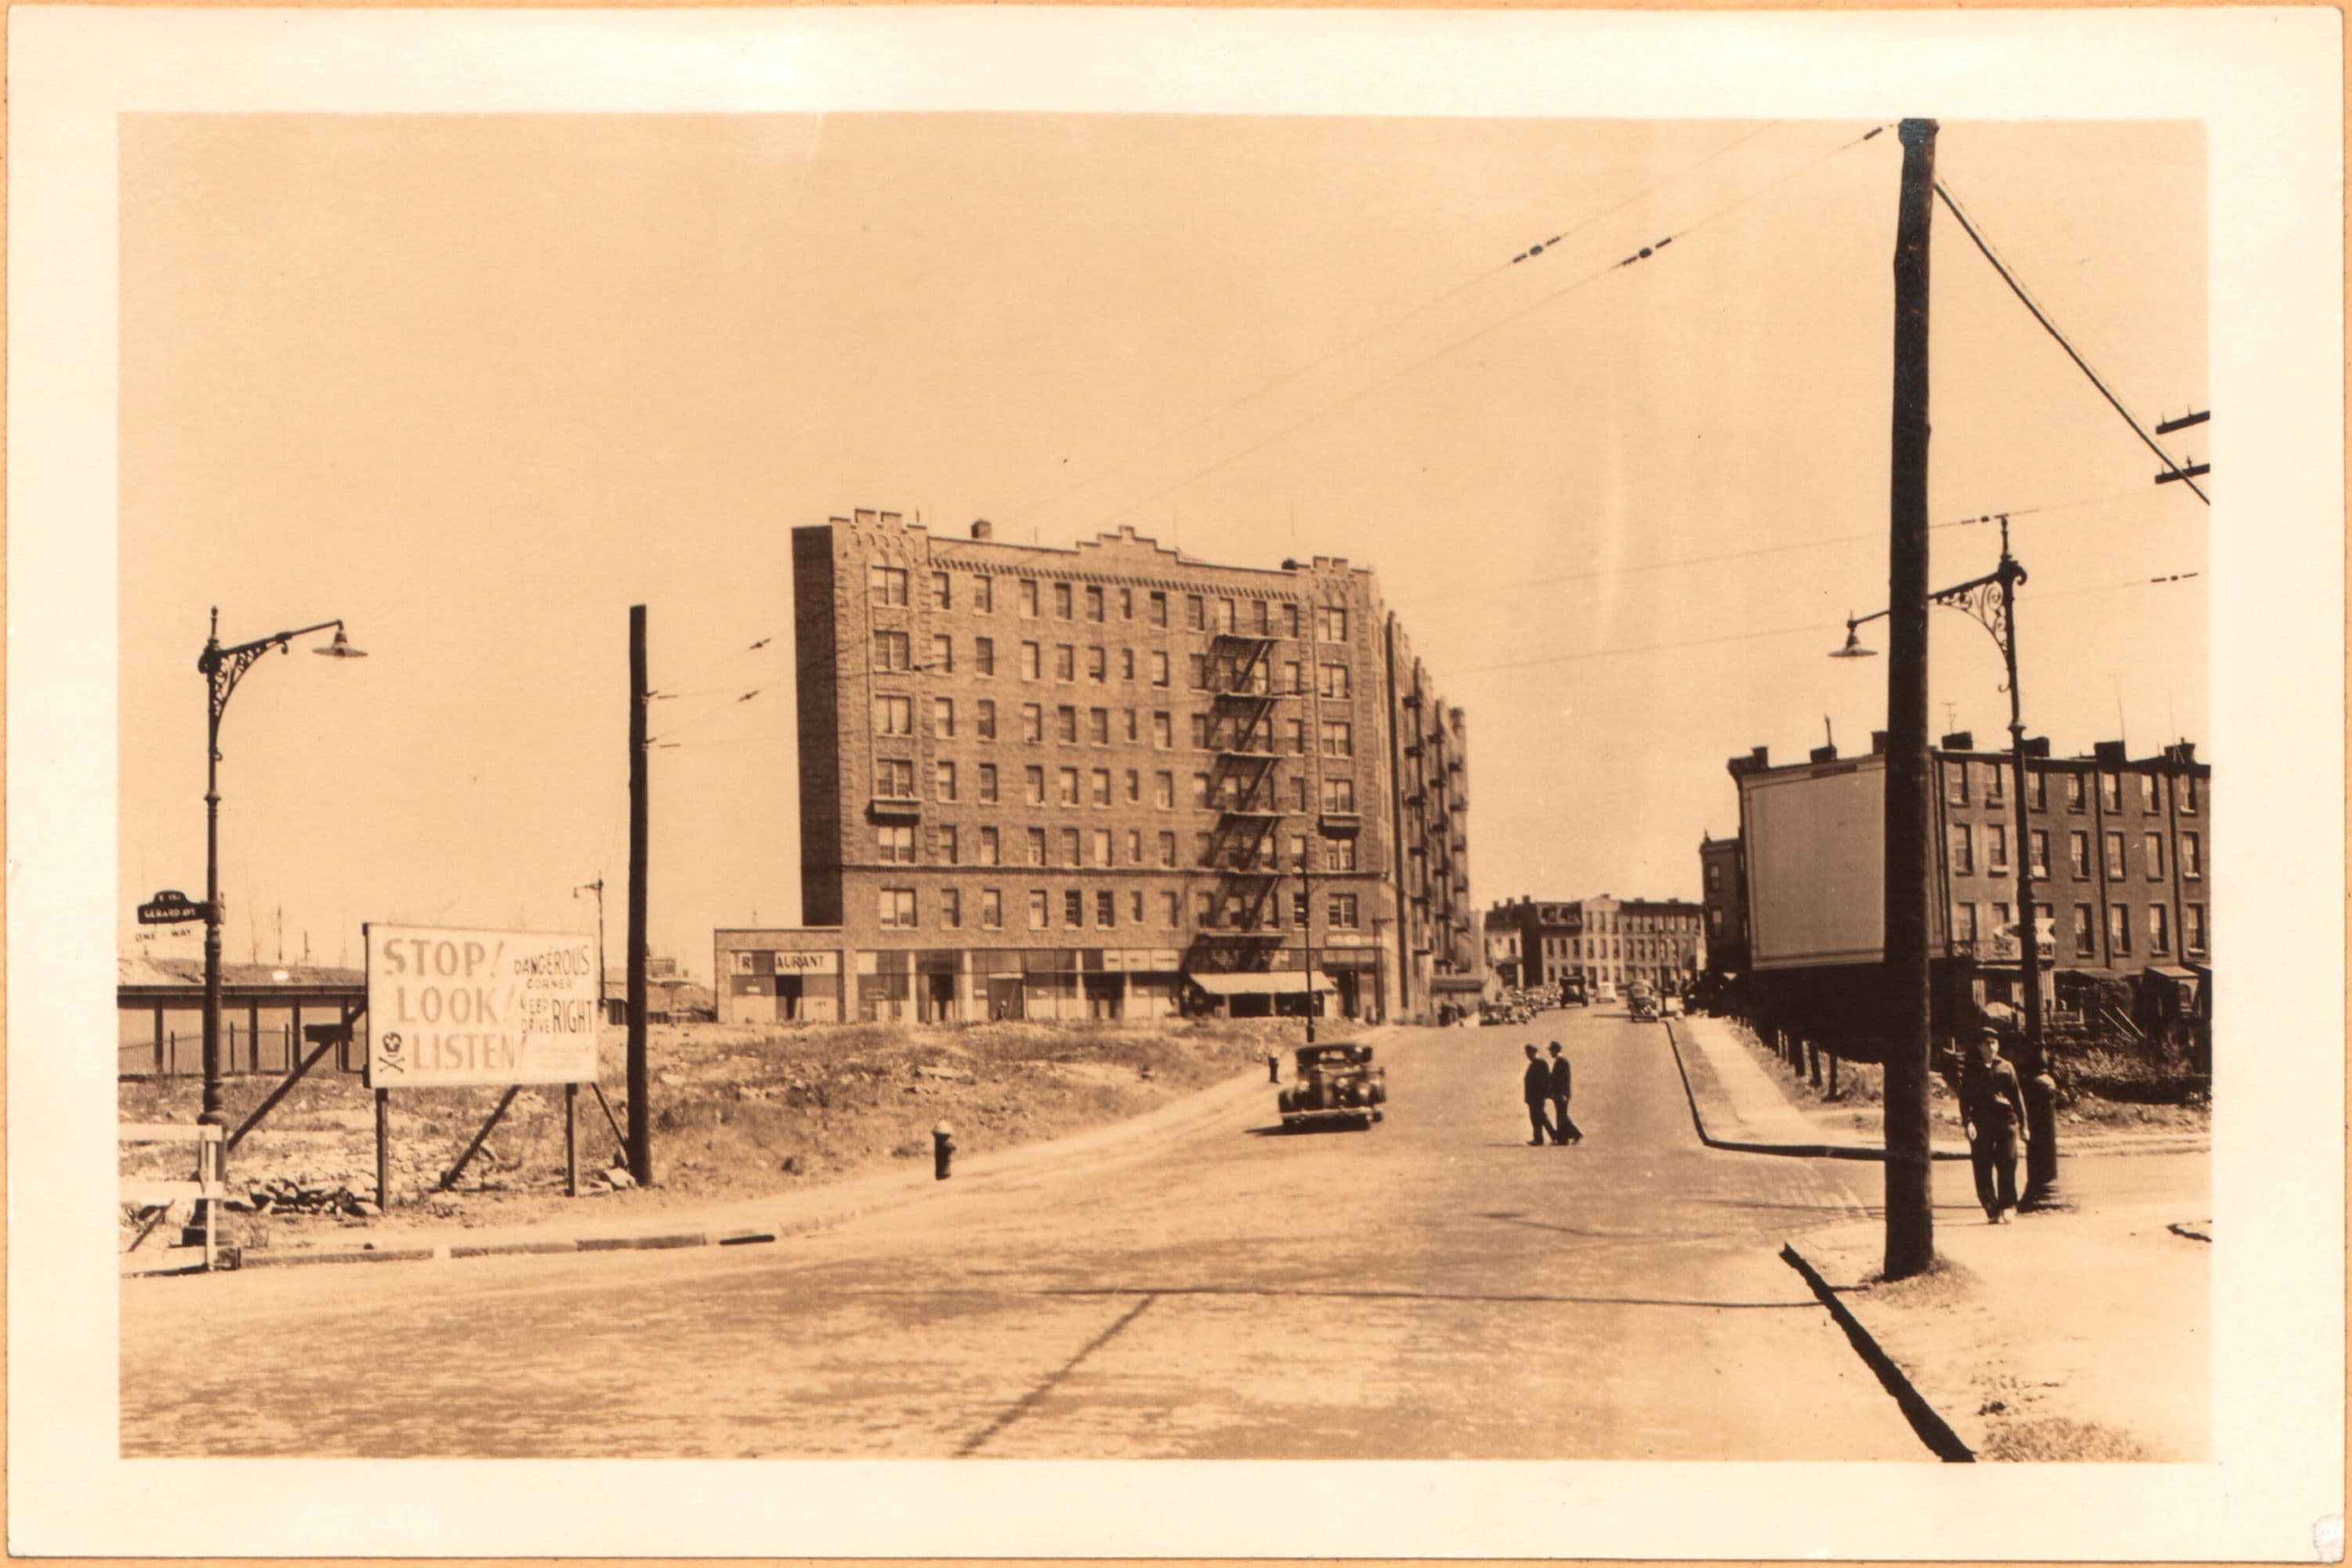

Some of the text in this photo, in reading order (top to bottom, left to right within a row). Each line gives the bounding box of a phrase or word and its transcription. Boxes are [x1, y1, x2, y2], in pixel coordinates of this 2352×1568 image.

[382, 939, 505, 978] STOP!
[513, 944, 590, 976] DANGEROUS
[741, 954, 824, 969] RAURANT
[526, 978, 573, 990] CORNER
[397, 984, 515, 1024] LOOK!
[552, 998, 593, 1034] RIGHT
[413, 1034, 527, 1070] LISTEN!
